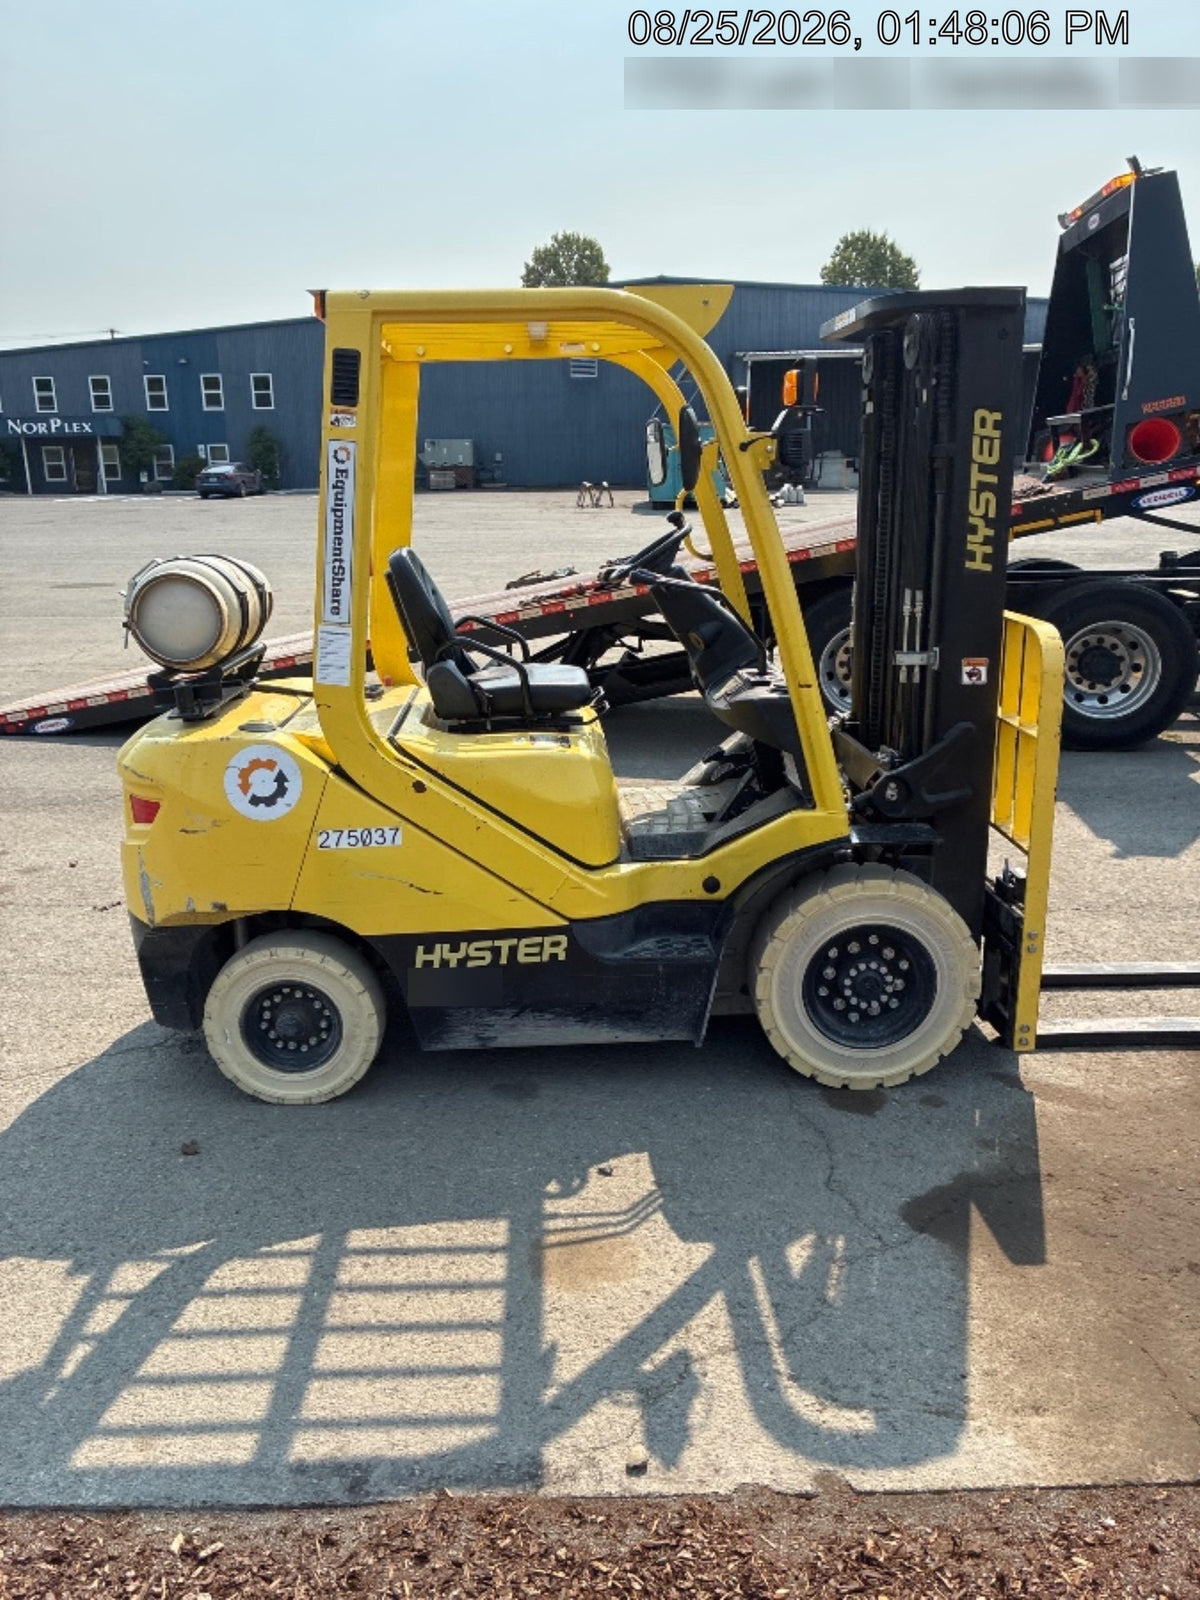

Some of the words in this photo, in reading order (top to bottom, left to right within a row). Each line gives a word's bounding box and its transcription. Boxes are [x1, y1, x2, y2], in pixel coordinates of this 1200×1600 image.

[965, 408, 1002, 571] HYSTER
[330, 468, 350, 616] EquipmentShare
[319, 827, 400, 848] 275037
[415, 934, 568, 968] HYSTER
